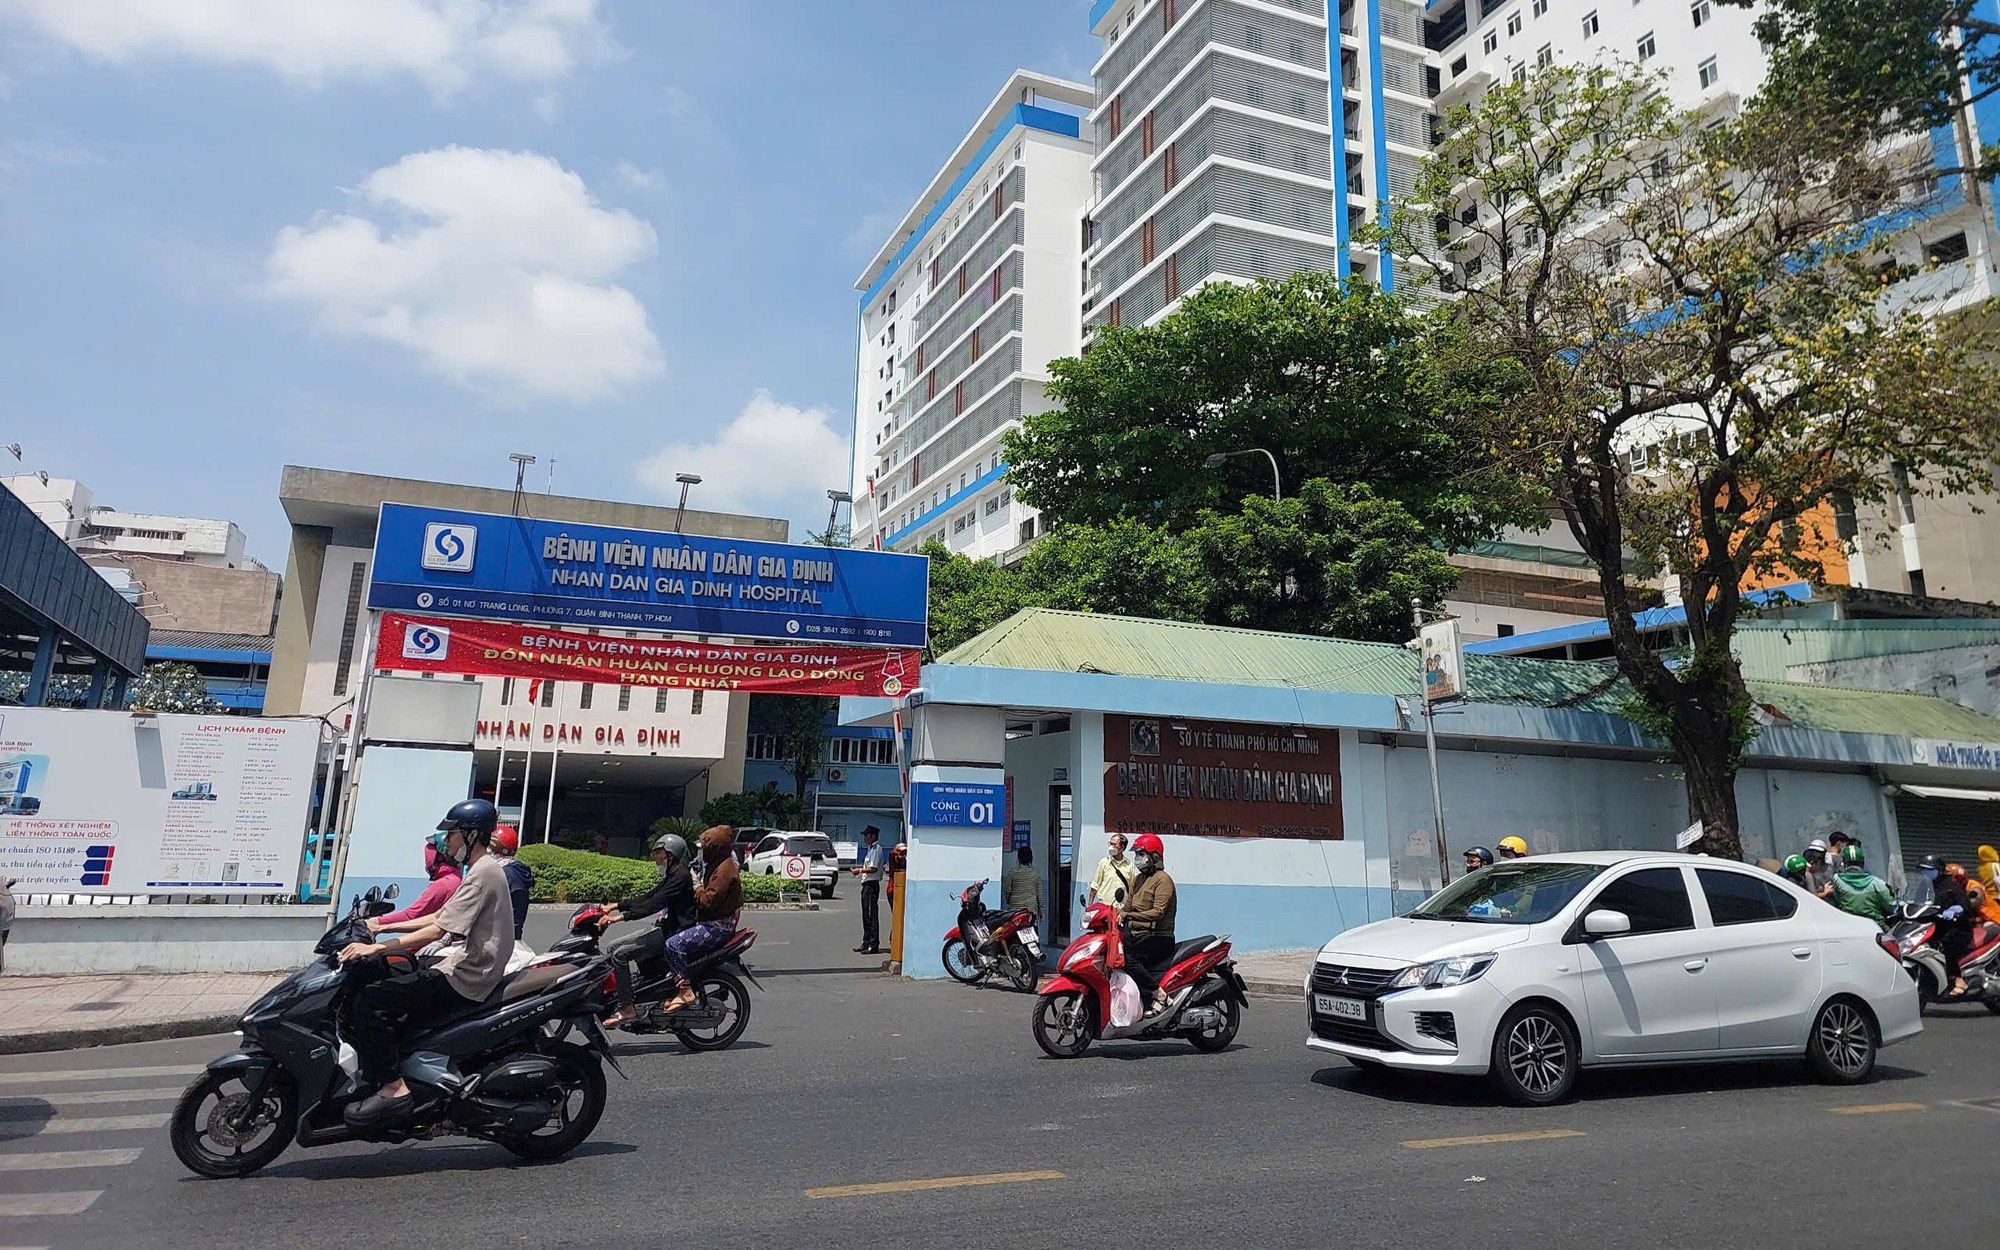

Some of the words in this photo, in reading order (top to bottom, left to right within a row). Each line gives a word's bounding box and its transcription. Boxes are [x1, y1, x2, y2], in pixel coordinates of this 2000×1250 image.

[543, 532, 596, 566] BỆNH
[603, 539, 645, 570] VIỆN
[652, 545, 706, 571] NHÂN
[712, 549, 752, 576] DÂN
[757, 557, 786, 579] GIA
[792, 559, 833, 584] ĐỊNH
[551, 568, 603, 588] NHAN
[609, 573, 648, 592] DAN
[655, 577, 684, 595] GIA
[692, 580, 732, 598] DINH
[739, 584, 822, 605] HOSPITAL
[438, 596, 450, 606] SỐ
[452, 599, 461, 607] 01
[479, 601, 506, 611] TRANG
[508, 604, 530, 613] LONG,
[575, 608, 596, 619] QUẬN
[599, 609, 615, 619] BÌNH
[645, 614, 672, 624] TP.HCM
[806, 625, 821, 635] (028)
[823, 626, 838, 636] 3841
[863, 629, 878, 638] 1900
[521, 634, 581, 651] BỆNH
[586, 641, 635, 656] VIỆN
[641, 643, 700, 659] NHÂN
[706, 648, 748, 662] DÂN
[753, 651, 785, 663] GIA
[790, 653, 838, 667] ĐỊNH
[483, 647, 533, 663] ĐÓN
[540, 652, 602, 668] NHẬN
[609, 657, 669, 672] HUÂN
[675, 661, 762, 678] CHƯƠNG
[768, 667, 804, 680] LAO
[810, 668, 865, 683] ĐỘNG
[619, 672, 679, 688] HẠNG
[686, 674, 742, 690] NHẤT
[258, 726, 286, 735] BỆNH
[476, 720, 531, 739] NHÂN
[543, 723, 582, 740] DÂN
[595, 725, 625, 744] GIA
[637, 726, 680, 749] ĐỊNH
[1179, 726, 1193, 747] SỞ
[1194, 732, 1202, 747] Y
[1202, 726, 1214, 748] TẾ
[1216, 730, 1245, 750] THÀNH
[1247, 730, 1266, 751] PHỐ
[1268, 732, 1280, 753] HỒ
[1297, 738, 1319, 755] MINH
[1936, 742, 1957, 764] NHÀ
[1117, 755, 1158, 802] BỆNH
[1163, 758, 1195, 805] VIỆN
[1200, 760, 1238, 801] NHÂN
[1243, 762, 1271, 802] DÂN
[1274, 770, 1298, 803] GIA
[1300, 772, 1333, 809] ĐỊNH
[934, 813, 960, 823] GATE
[969, 802, 994, 824] 01
[26, 820, 56, 829] THỐNG
[58, 821, 76, 829] XÉT
[77, 822, 112, 830] NGHIỆM
[29, 830, 59, 838] THÔNG
[87, 830, 112, 838] QUỐC
[36, 846, 51, 854] ISO
[54, 846, 75, 854] 15189
[11, 860, 24, 868] thu
[45, 861, 56, 870] tại
